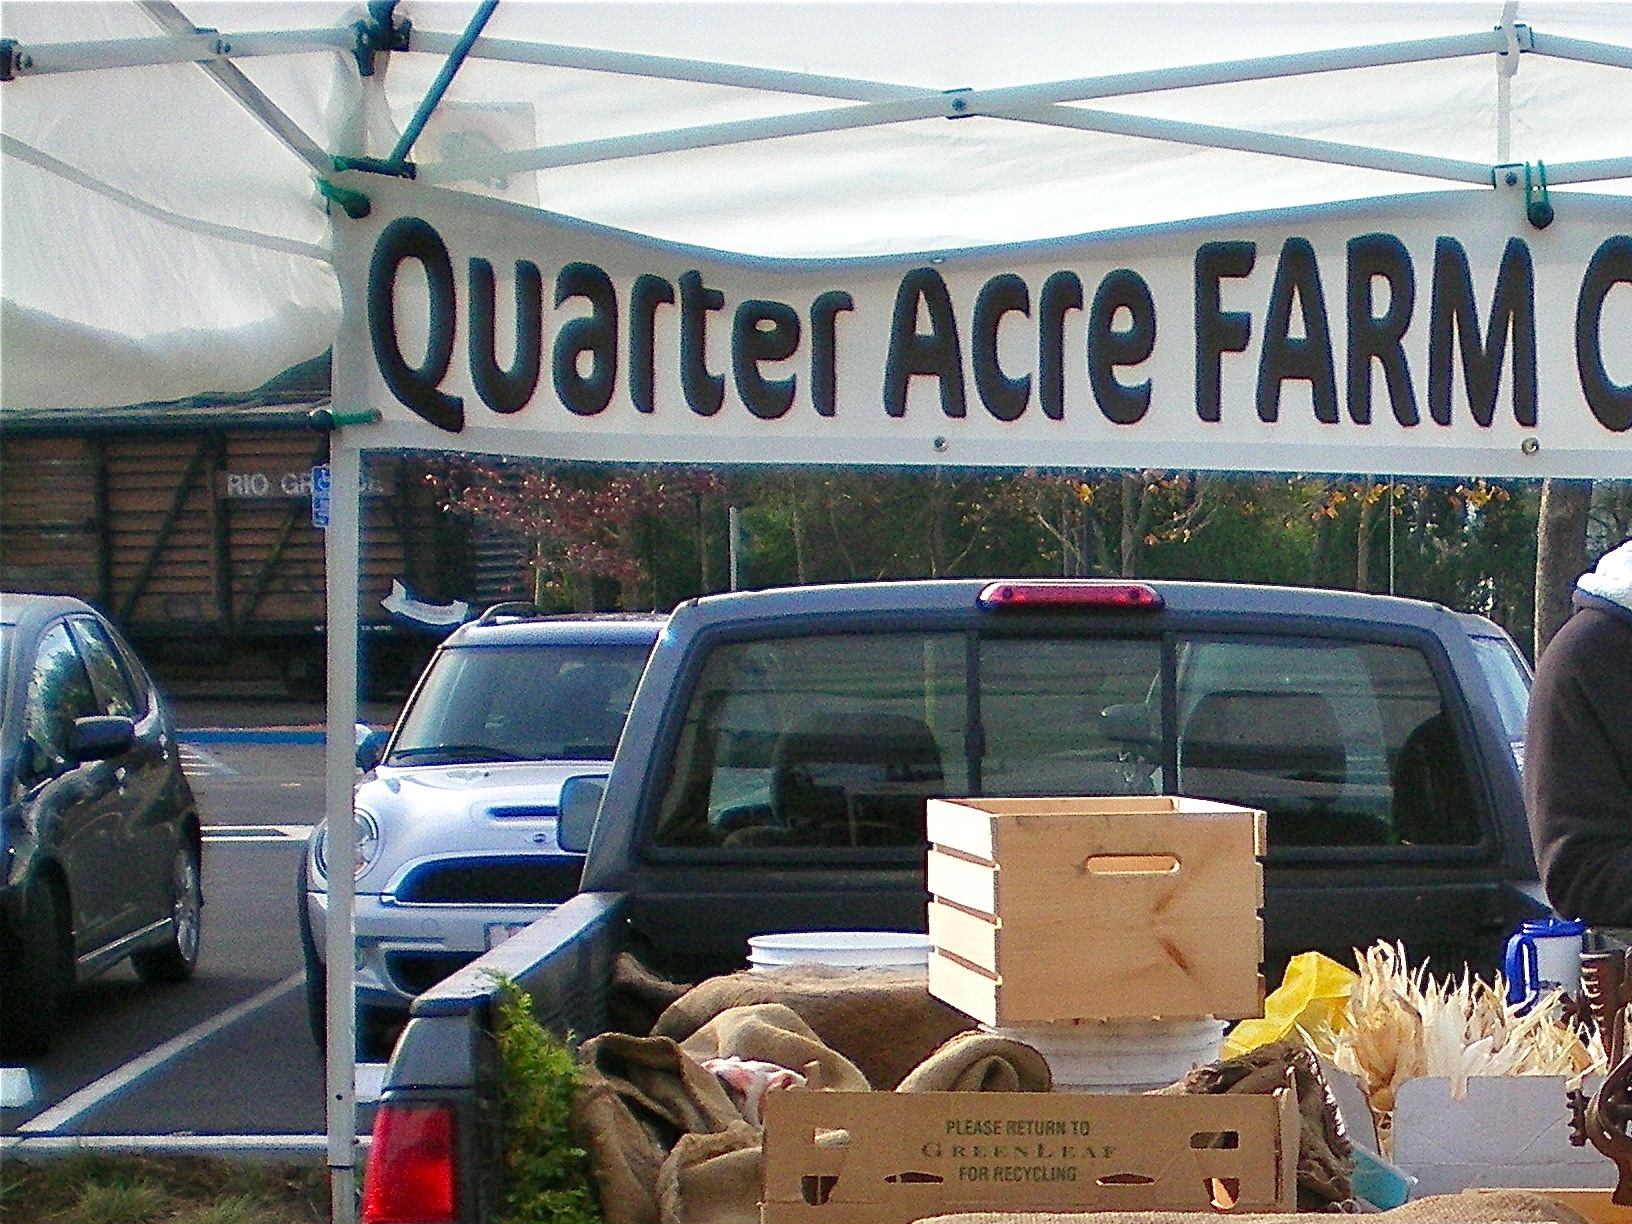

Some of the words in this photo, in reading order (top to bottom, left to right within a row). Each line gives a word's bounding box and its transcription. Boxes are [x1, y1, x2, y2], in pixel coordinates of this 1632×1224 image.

[367, 216, 854, 433] Quarter
[882, 267, 1158, 426] Acre
[1194, 232, 1538, 428] FARM
[227, 472, 270, 496] RIO
[945, 1119, 1001, 1136] PLEASE
[1006, 1119, 1066, 1136] RETURN
[1072, 1120, 1090, 1136] TO
[958, 1166, 989, 1182] FOR
[993, 1166, 1078, 1182] RECYCLING
